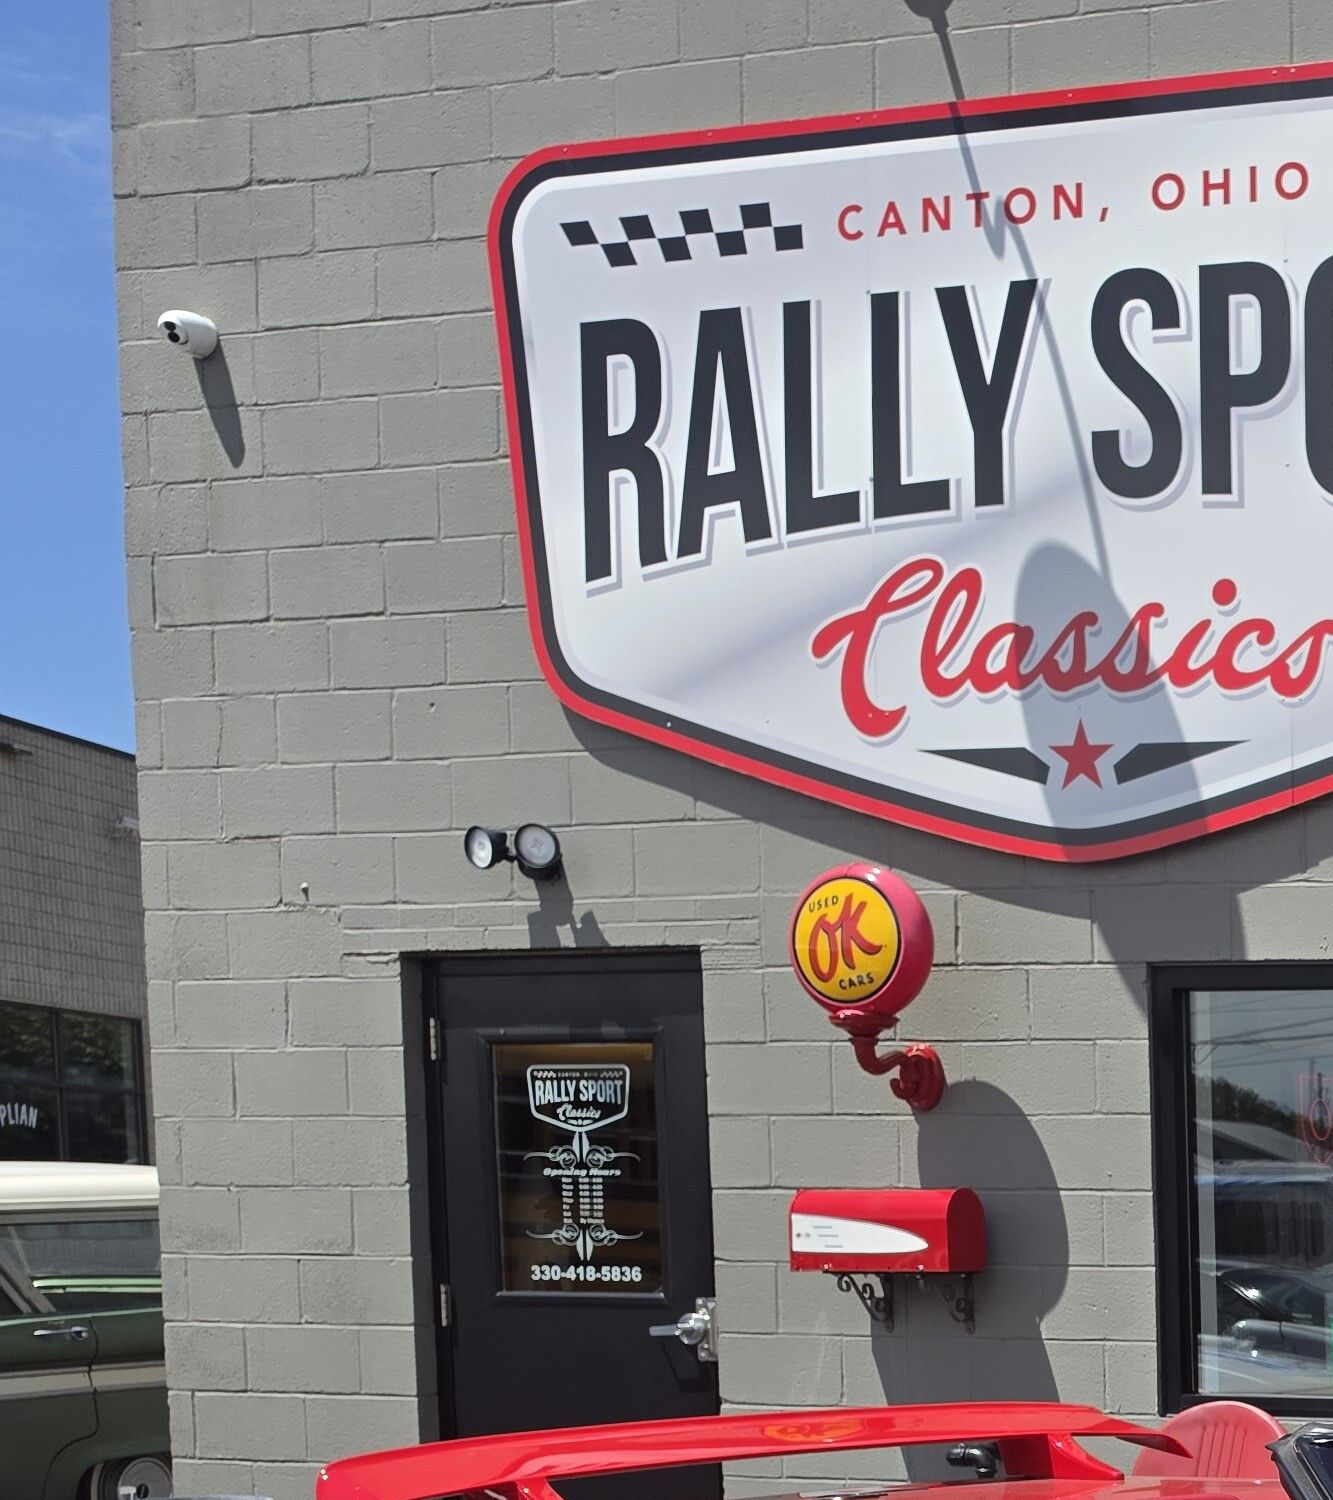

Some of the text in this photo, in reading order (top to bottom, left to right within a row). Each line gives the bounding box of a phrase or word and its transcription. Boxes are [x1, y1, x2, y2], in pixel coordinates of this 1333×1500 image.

[837, 160, 1313, 244] CANTON, OHIO
[577, 277, 1040, 583] RALLY
[808, 895, 839, 912] USED
[809, 892, 883, 983] OK
[838, 972, 874, 990] CARS
[534, 1079, 623, 1106] RALLY SPORT
[556, 1103, 602, 1121] Classics
[531, 1264, 643, 1283] 330-418-5836
